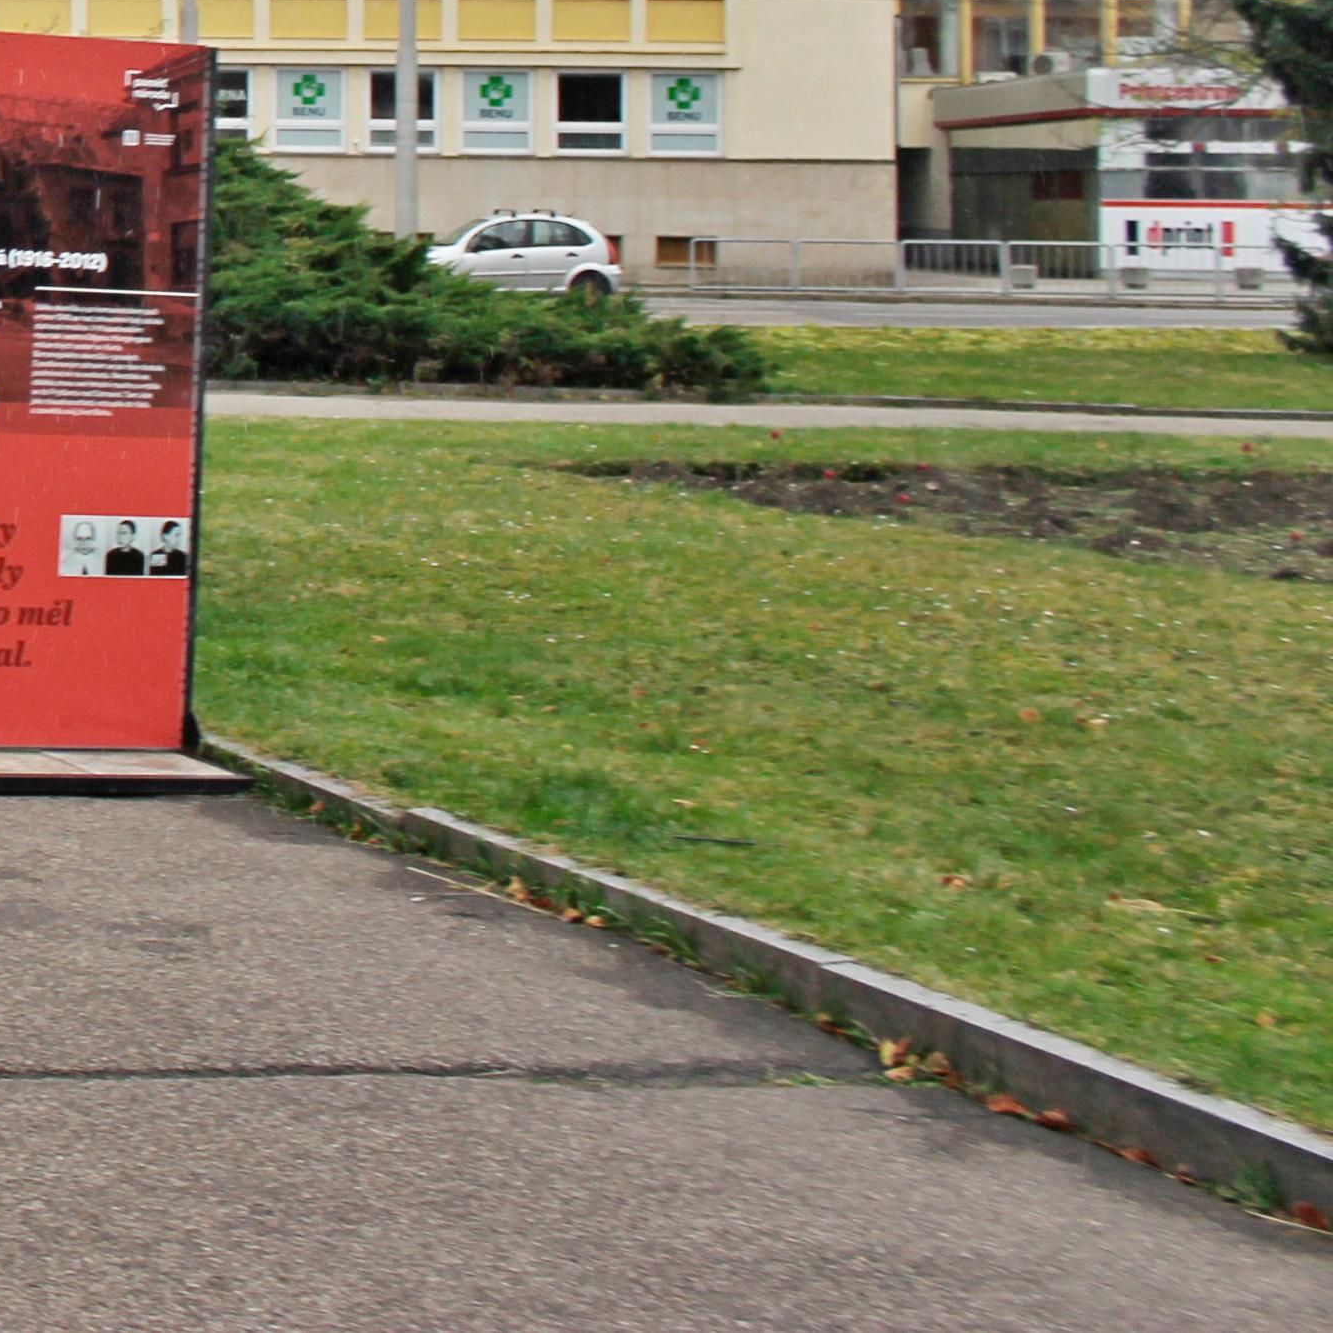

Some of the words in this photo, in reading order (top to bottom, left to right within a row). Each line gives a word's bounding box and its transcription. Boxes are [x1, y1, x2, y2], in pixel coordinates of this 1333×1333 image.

[292, 106, 326, 117] BENU
[479, 108, 514, 119] BENU
[667, 111, 702, 121] BENU
[17, 598, 74, 627] měl
